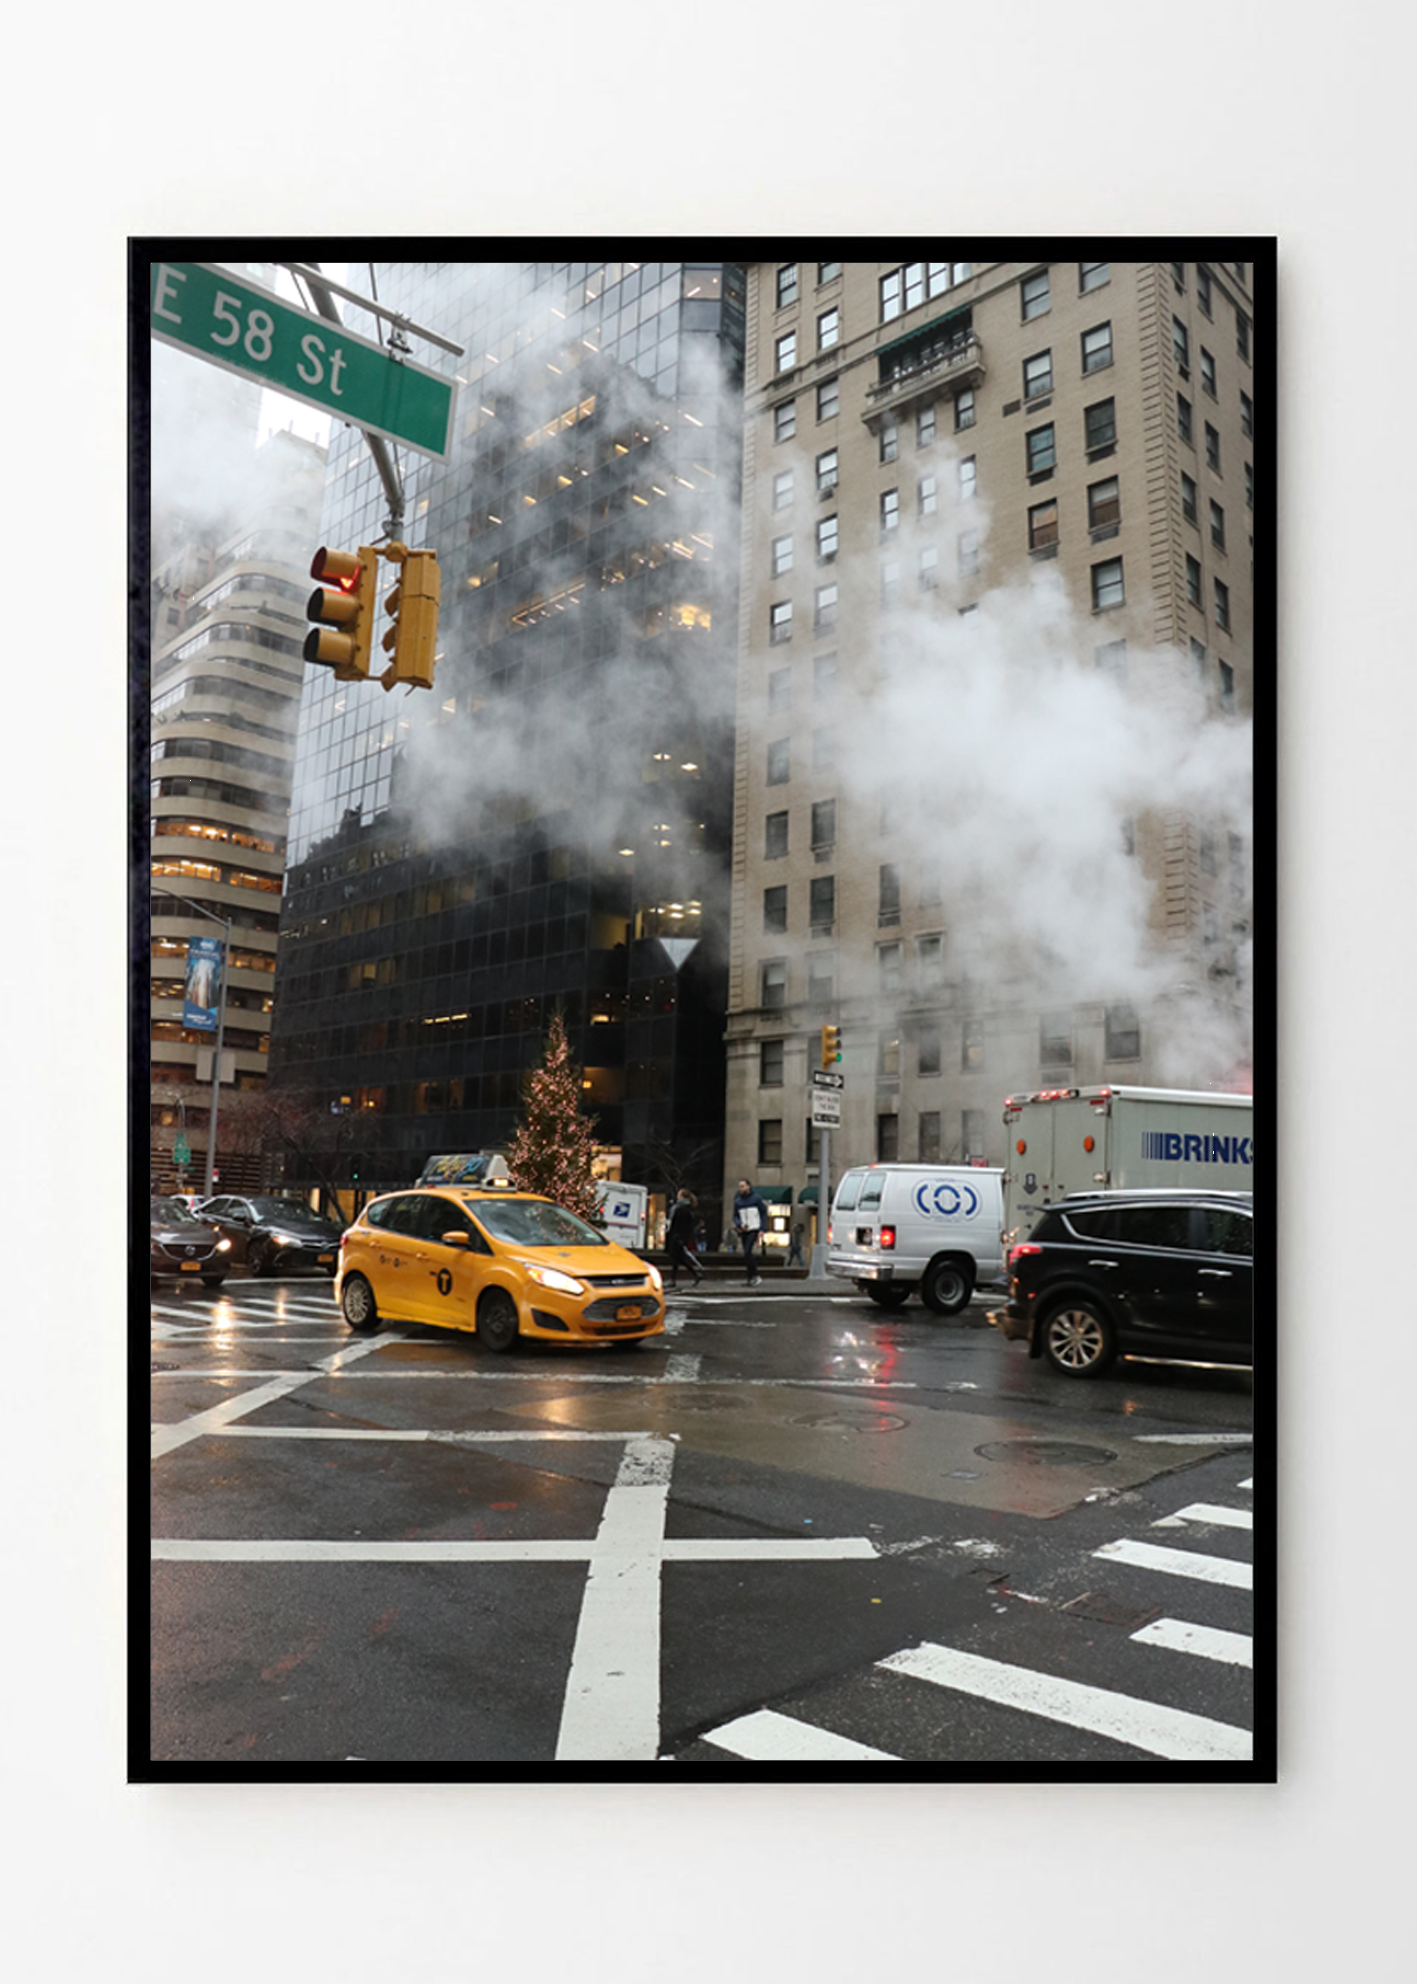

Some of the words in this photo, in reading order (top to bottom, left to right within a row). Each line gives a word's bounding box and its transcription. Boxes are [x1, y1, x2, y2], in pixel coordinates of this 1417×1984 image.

[153, 263, 187, 325] E
[209, 290, 275, 362] 58
[296, 333, 347, 396] St
[1164, 1132, 1254, 1165] BRINK
